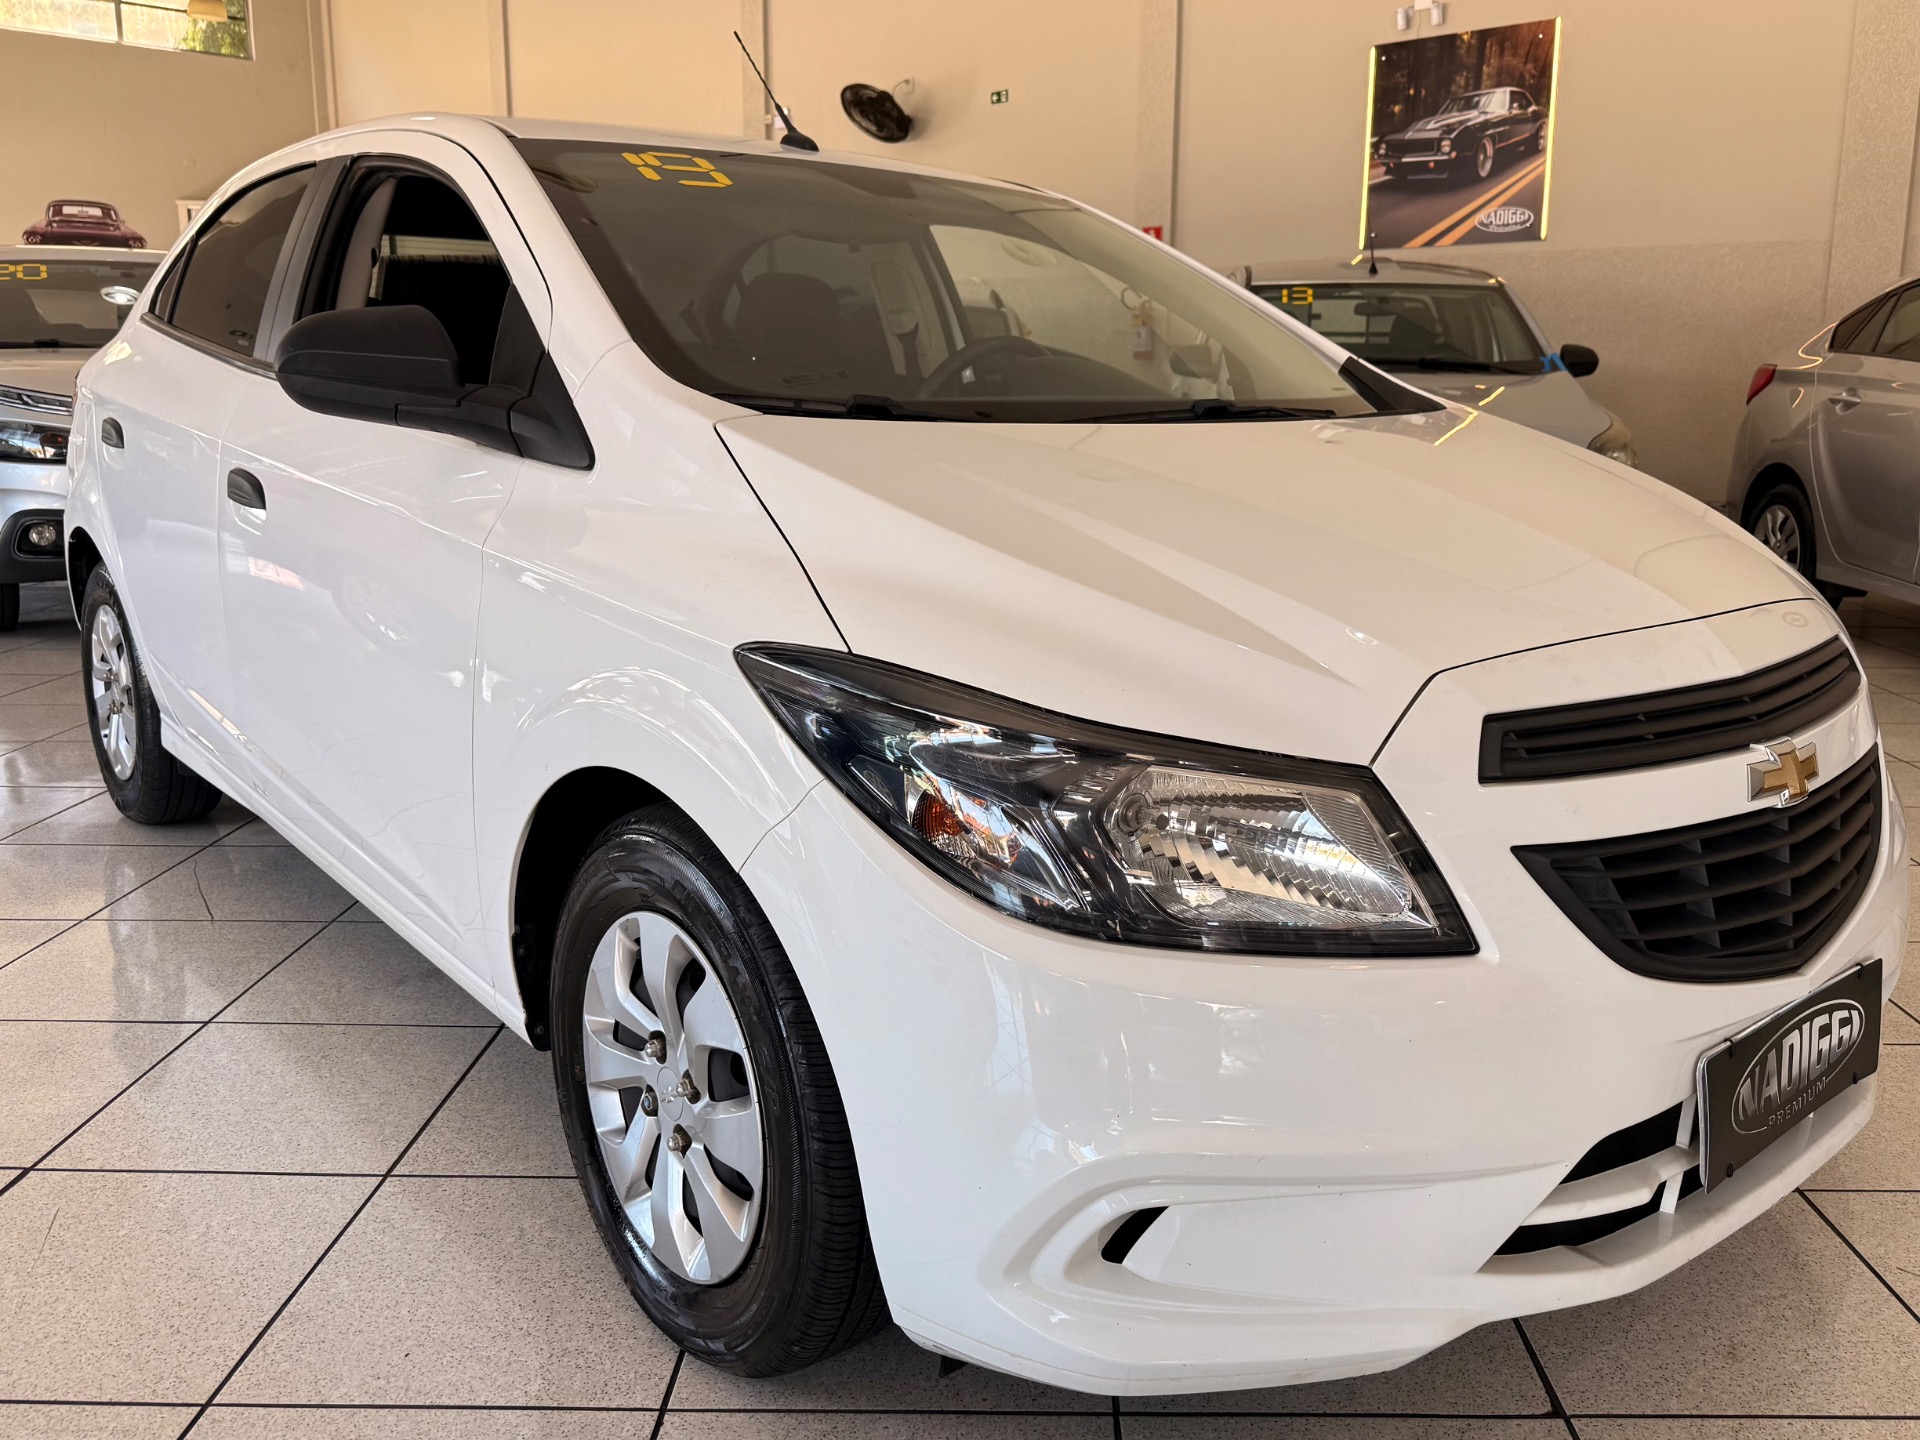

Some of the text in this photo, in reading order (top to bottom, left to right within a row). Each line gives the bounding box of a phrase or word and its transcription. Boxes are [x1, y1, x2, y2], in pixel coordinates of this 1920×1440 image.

[621, 151, 734, 188] 19
[1479, 209, 1529, 225] NADIGGI
[1281, 287, 1314, 305] 13
[1738, 1009, 1861, 1121] NADIGGI
[1768, 1076, 1827, 1130] PREMIUM
